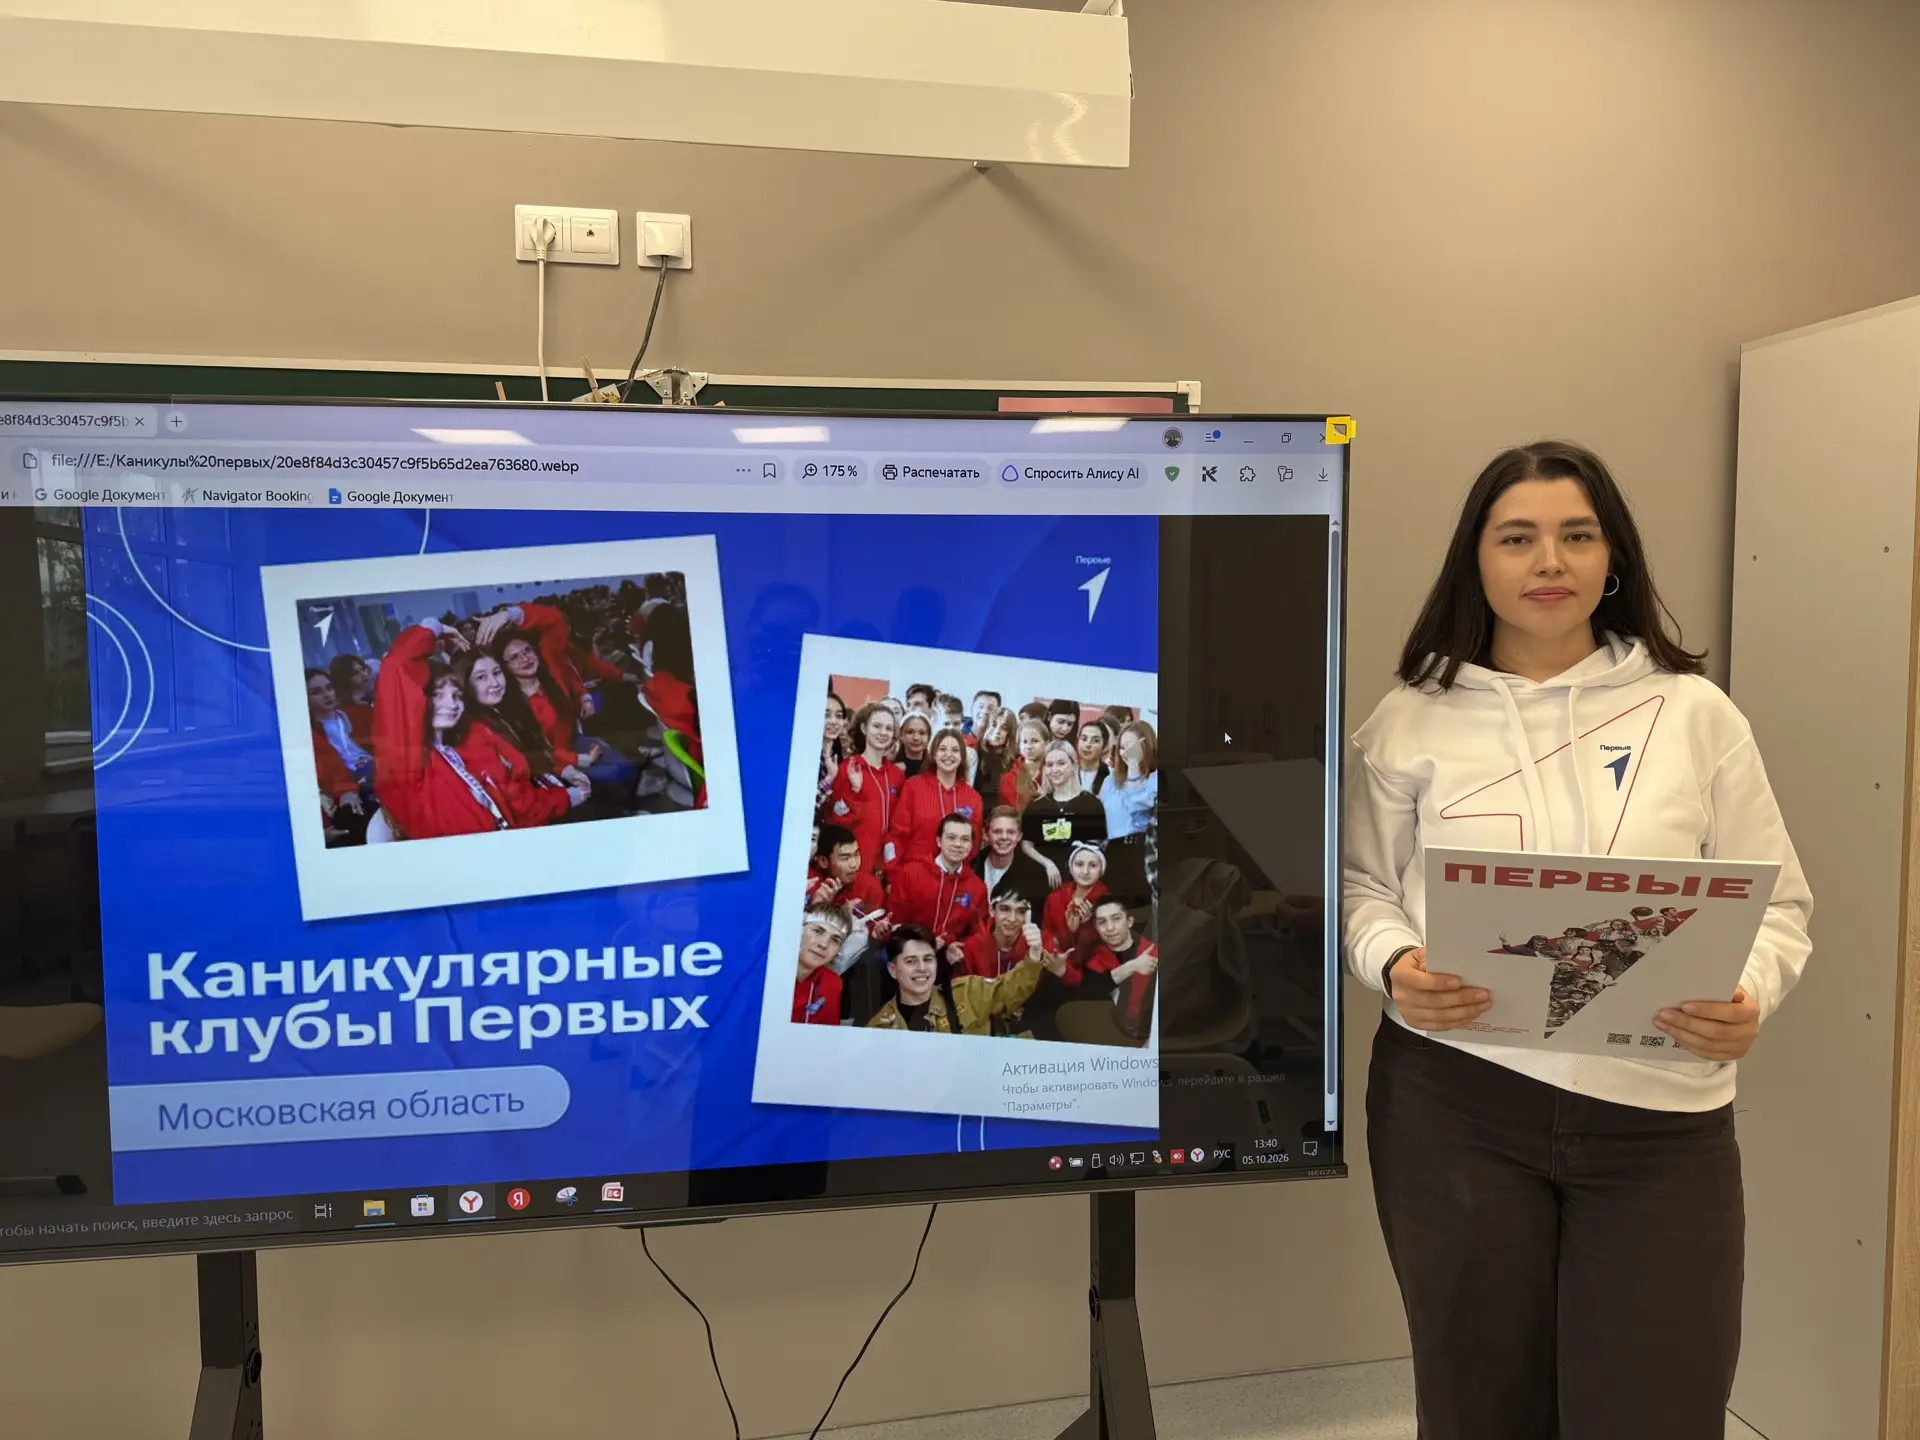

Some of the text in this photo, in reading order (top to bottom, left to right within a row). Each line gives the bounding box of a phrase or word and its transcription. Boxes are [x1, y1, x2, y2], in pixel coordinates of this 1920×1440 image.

[902, 466, 980, 480] Распечатать
[1024, 467, 1083, 481] Спросить
[1086, 468, 1121, 481] Алису
[53, 489, 99, 502] Google
[202, 490, 262, 503] Navigator
[347, 490, 390, 503] Google
[1600, 744, 1632, 752] Первые
[1444, 862, 1753, 900] ПЕРВЫЕ
[147, 939, 724, 1002] Каникулярные
[149, 994, 711, 1063] клубы Первых
[1002, 1056, 1159, 1077] Активация Windows
[1002, 1084, 1039, 1094] Чтобы
[1041, 1080, 1119, 1093] активировать
[1177, 1073, 1235, 1088] перейдите
[158, 1092, 525, 1132] Московская область
[1002, 1098, 1081, 1114] "Параметры".
[1254, 1138, 1278, 1149] 13:40
[1213, 1149, 1231, 1159] РУС
[1242, 1153, 1290, 1165] 05.10.2026
[38, 1221, 88, 1235] начать
[92, 1219, 138, 1232] поиск,
[142, 1214, 199, 1228] введите
[202, 1213, 241, 1226] здесь
[244, 1209, 293, 1224] запрос
